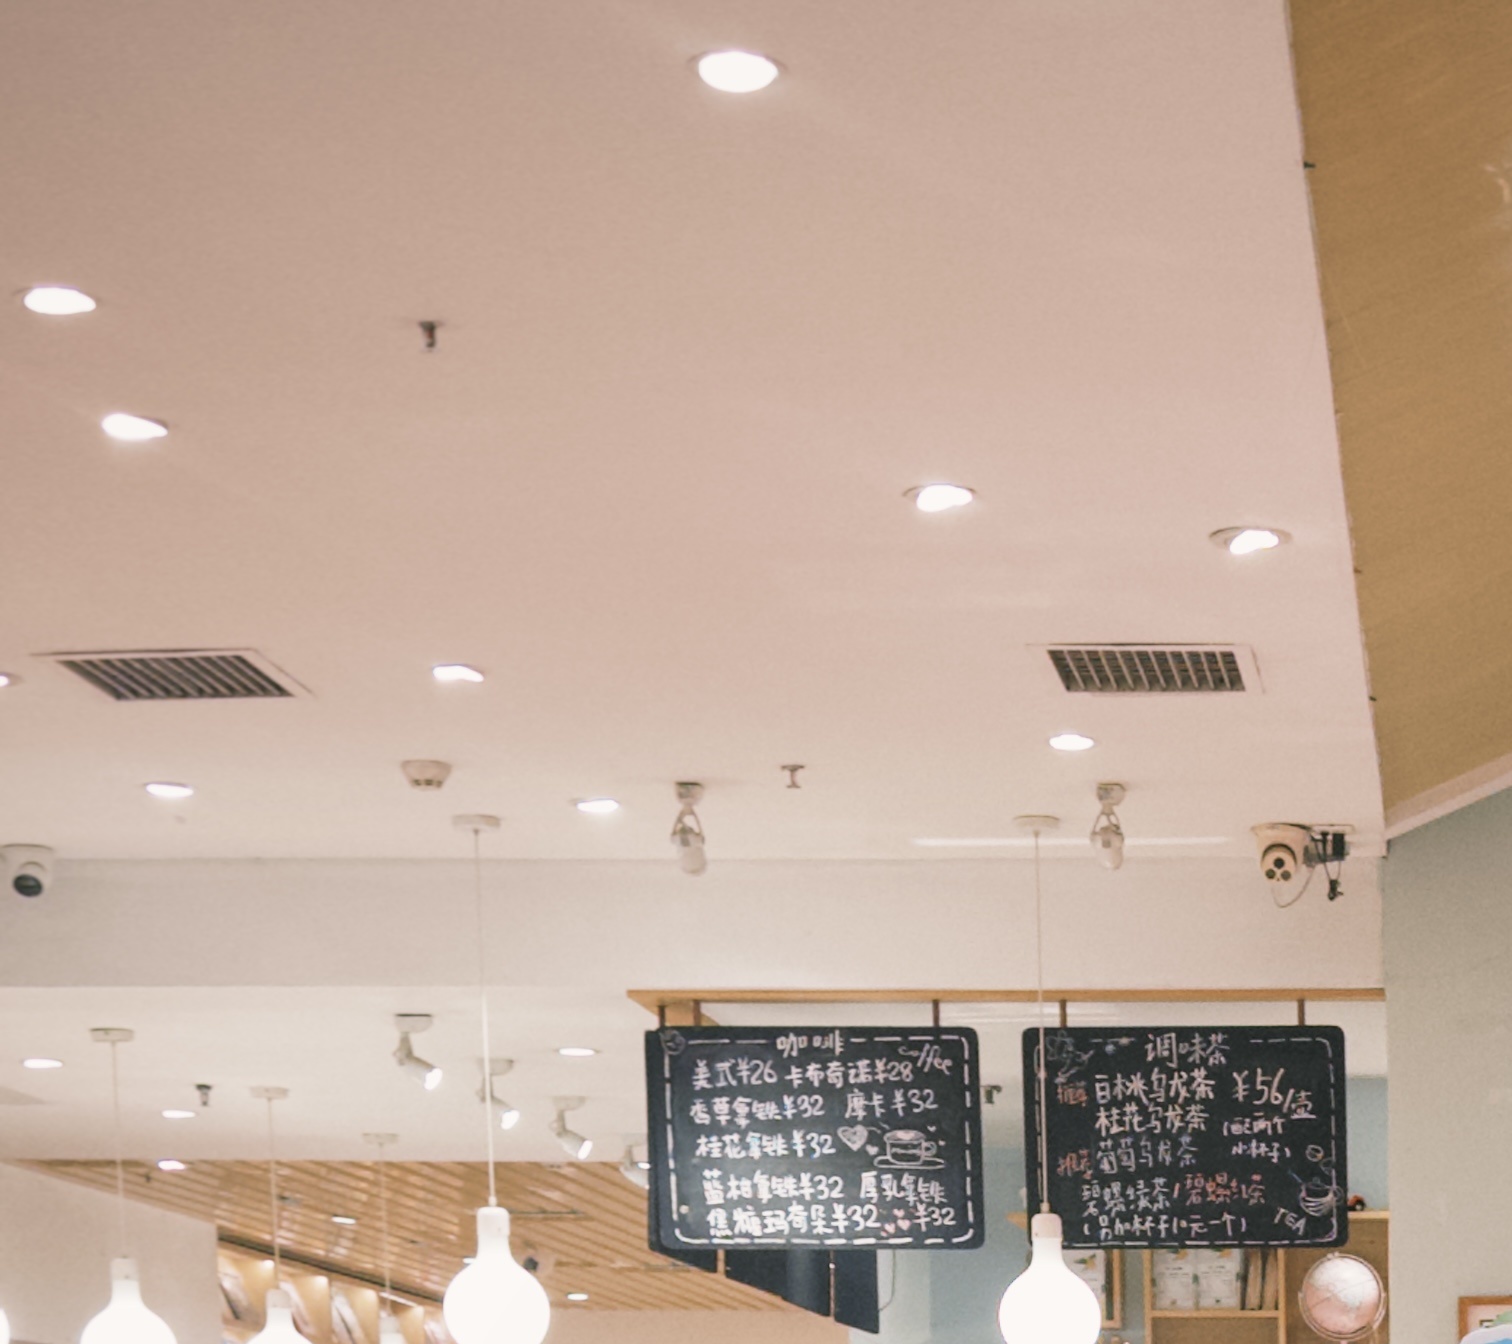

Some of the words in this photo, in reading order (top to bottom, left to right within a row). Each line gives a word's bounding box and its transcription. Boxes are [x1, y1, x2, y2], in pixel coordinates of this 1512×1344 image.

[776, 1029, 845, 1057] 咖啡
[1145, 1032, 1230, 1068] 调味茶
[1273, 1207, 1307, 1236] TEA
